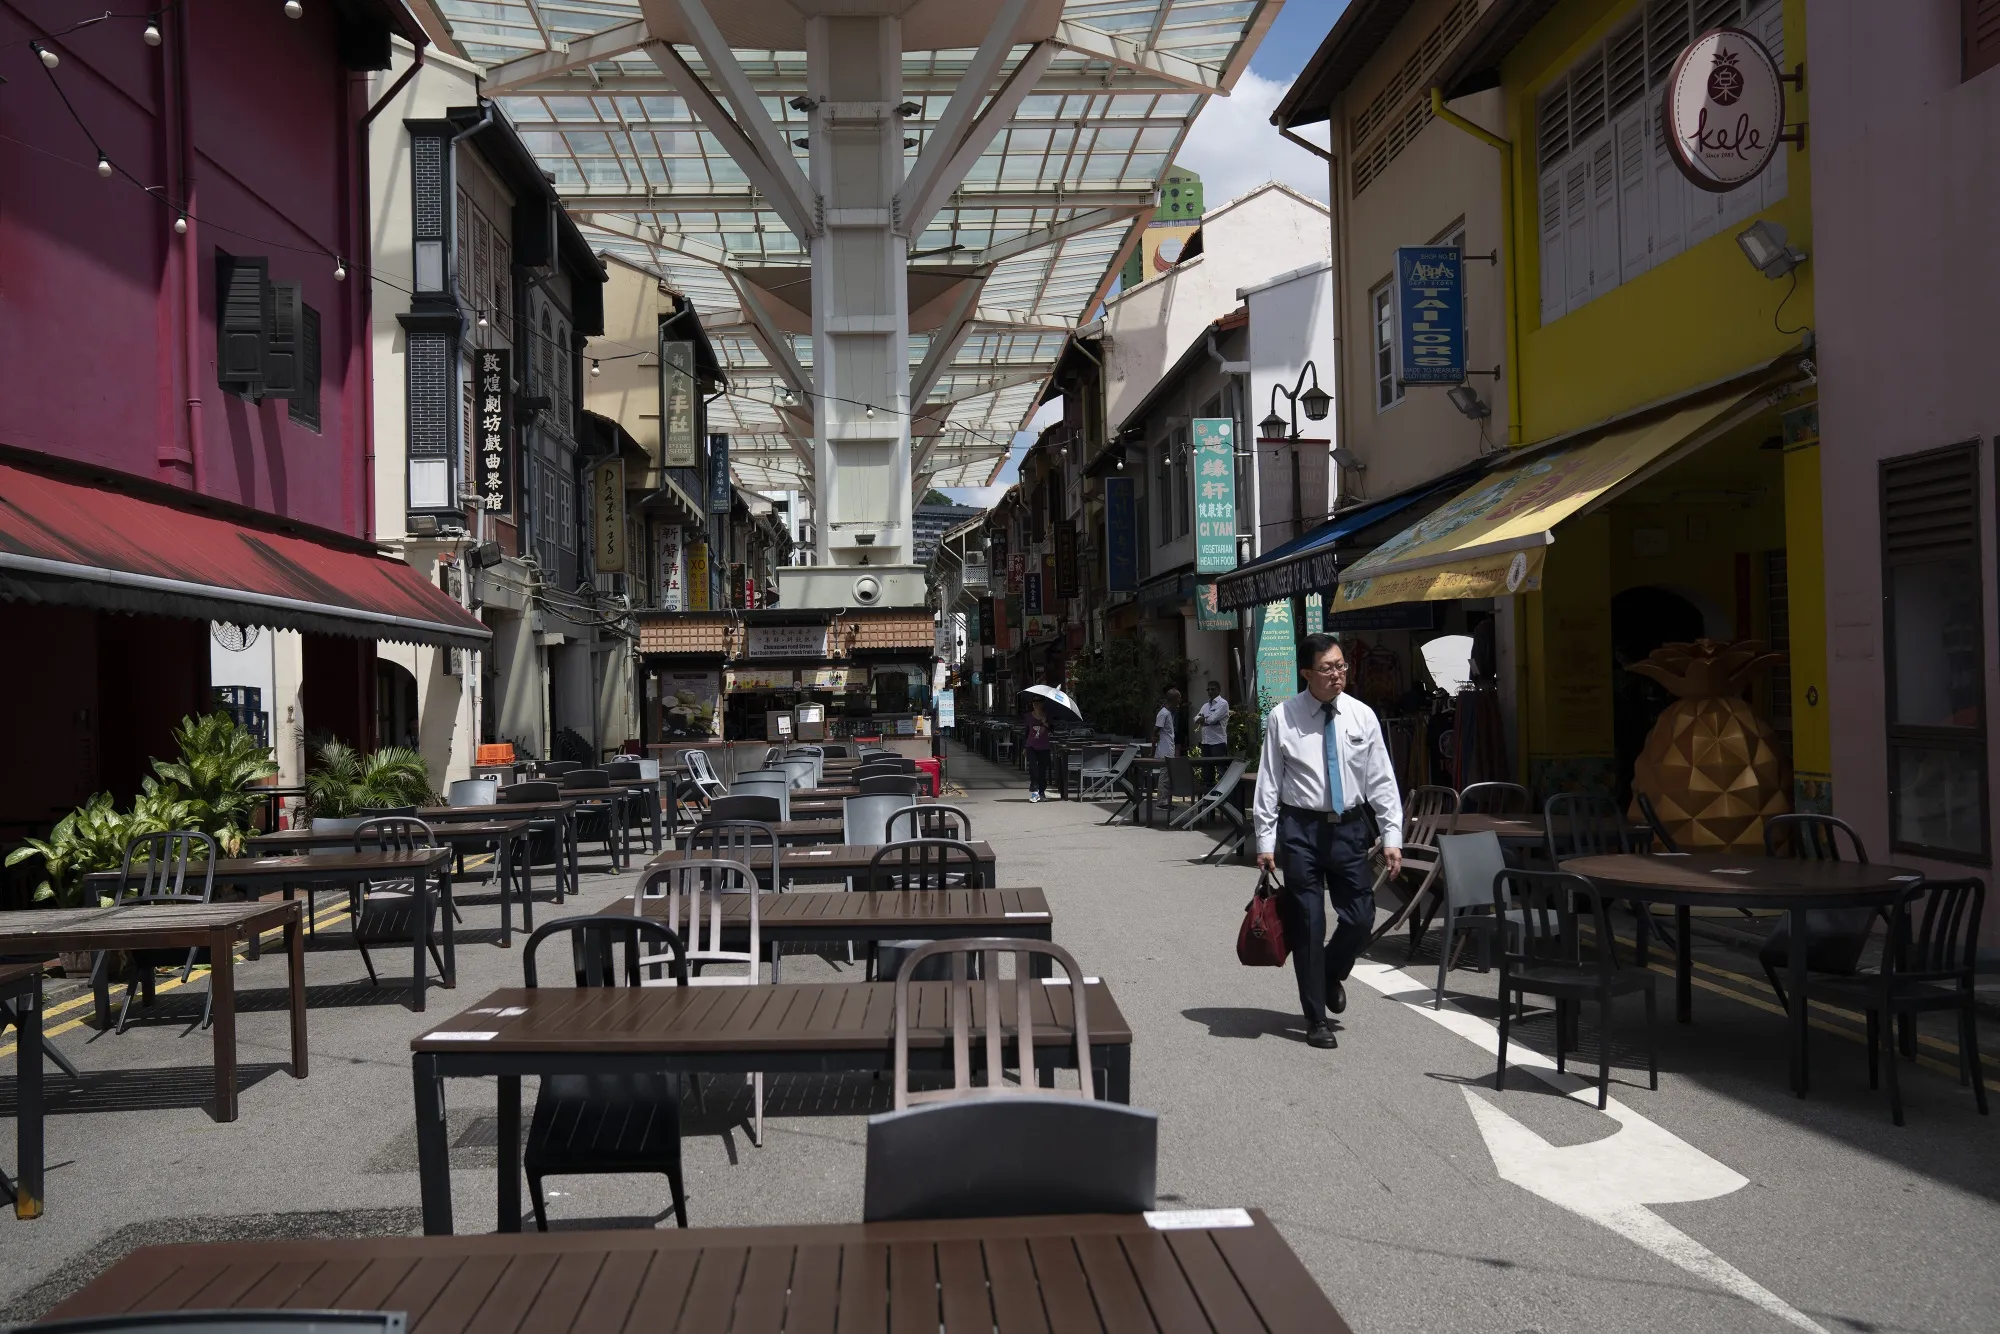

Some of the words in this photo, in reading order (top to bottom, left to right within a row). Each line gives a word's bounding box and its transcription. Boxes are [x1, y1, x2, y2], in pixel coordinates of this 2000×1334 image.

[1688, 108, 1766, 161] kele
[1412, 287, 1451, 367] TAILORS
[482, 353, 504, 511] 敦煌劇坊戲曲茶館
[1199, 503, 1233, 518] 健康素食
[1200, 522, 1212, 536] CI
[1213, 522, 1232, 536] YAN
[662, 528, 680, 593] 新聲詩社
[1201, 544, 1233, 554] VEGETARIAN
[690, 559, 706, 570] XO
[1200, 556, 1218, 566] HEALTH
[1219, 556, 1235, 566] FOOD
[1301, 559, 1312, 590] ALL
